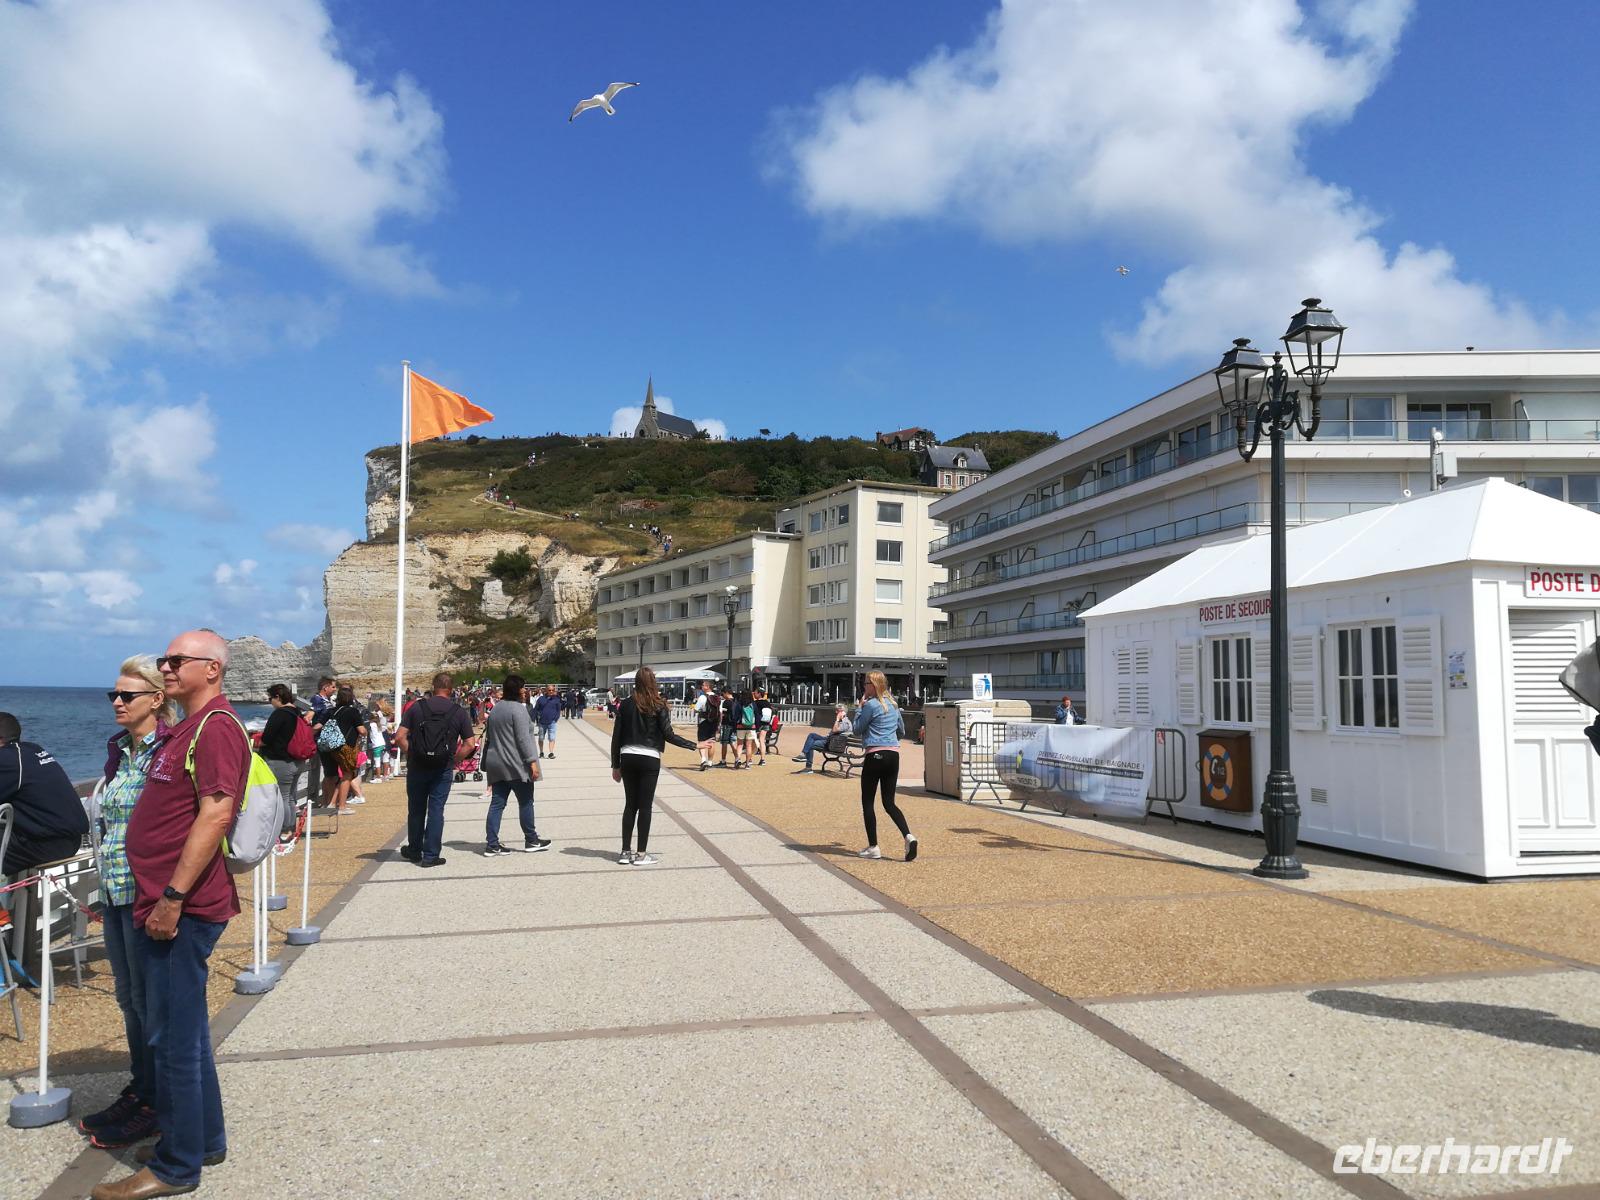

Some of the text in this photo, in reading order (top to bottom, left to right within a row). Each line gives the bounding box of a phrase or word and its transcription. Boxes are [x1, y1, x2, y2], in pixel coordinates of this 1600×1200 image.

[1530, 571, 1600, 592] POSTE D
[1199, 598, 1273, 622] POSTE DE SECOUR
[1106, 759, 1140, 769] BAIGNADE
